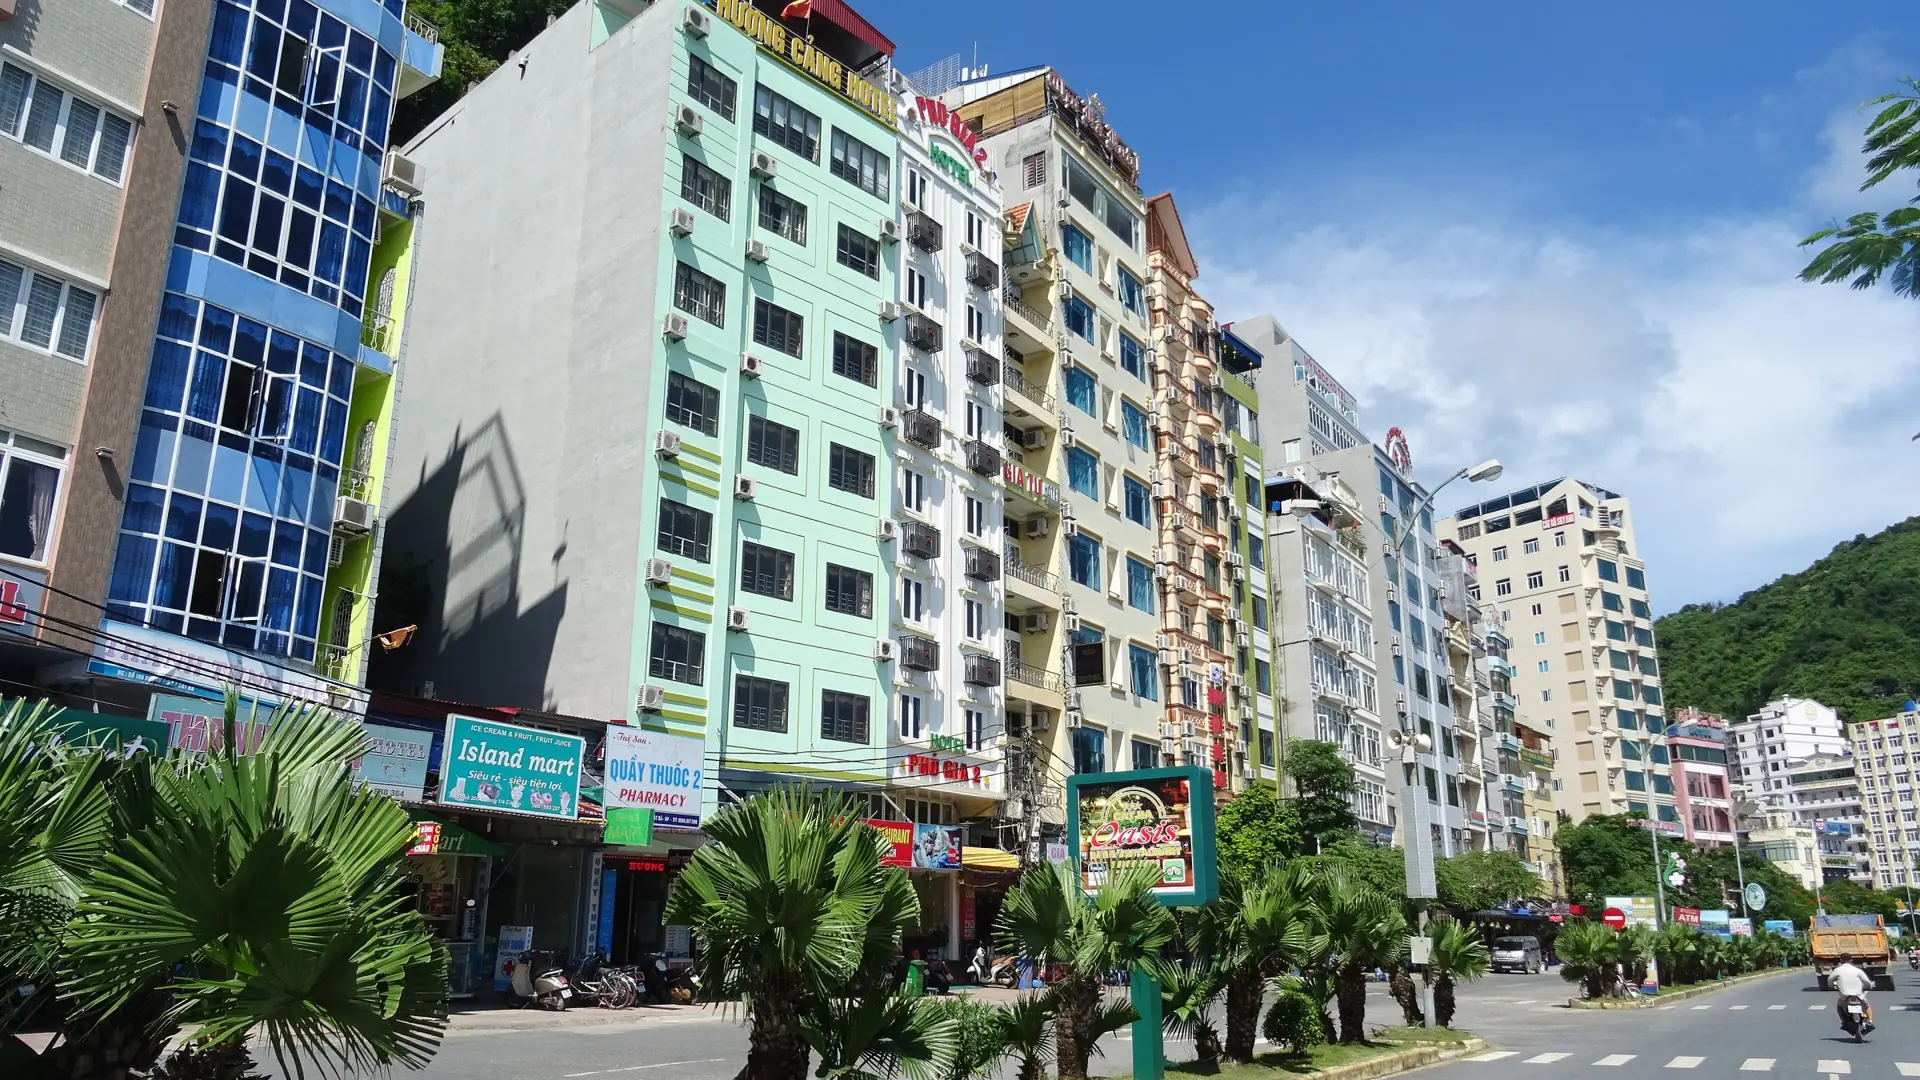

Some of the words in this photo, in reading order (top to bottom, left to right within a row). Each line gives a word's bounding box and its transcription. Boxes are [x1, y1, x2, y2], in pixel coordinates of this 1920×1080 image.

[791, 34, 842, 90] CẢNG
[847, 70, 898, 125] HOTEL
[930, 140, 973, 189] HOTEL
[974, 147, 988, 169] 2
[471, 724, 483, 733] ICE
[483, 725, 508, 737] CREAM
[535, 735, 553, 744] FRUIT
[554, 739, 573, 748] JUICE
[930, 732, 966, 754] HOTEL
[458, 739, 525, 769] Island
[528, 755, 575, 777] mart
[907, 752, 940, 777] PHÚ
[943, 760, 969, 781] GIA
[971, 765, 981, 784] 2
[468, 770, 489, 781] Siêu
[509, 776, 527, 786] siêu
[610, 753, 645, 782] QUẦY
[649, 760, 689, 788] THUỐC
[693, 769, 701, 789] 2
[619, 788, 687, 807] PHARMACY
[439, 832, 465, 851] art
[1090, 820, 1180, 848] Oasis
[1679, 913, 1698, 923] ATM
